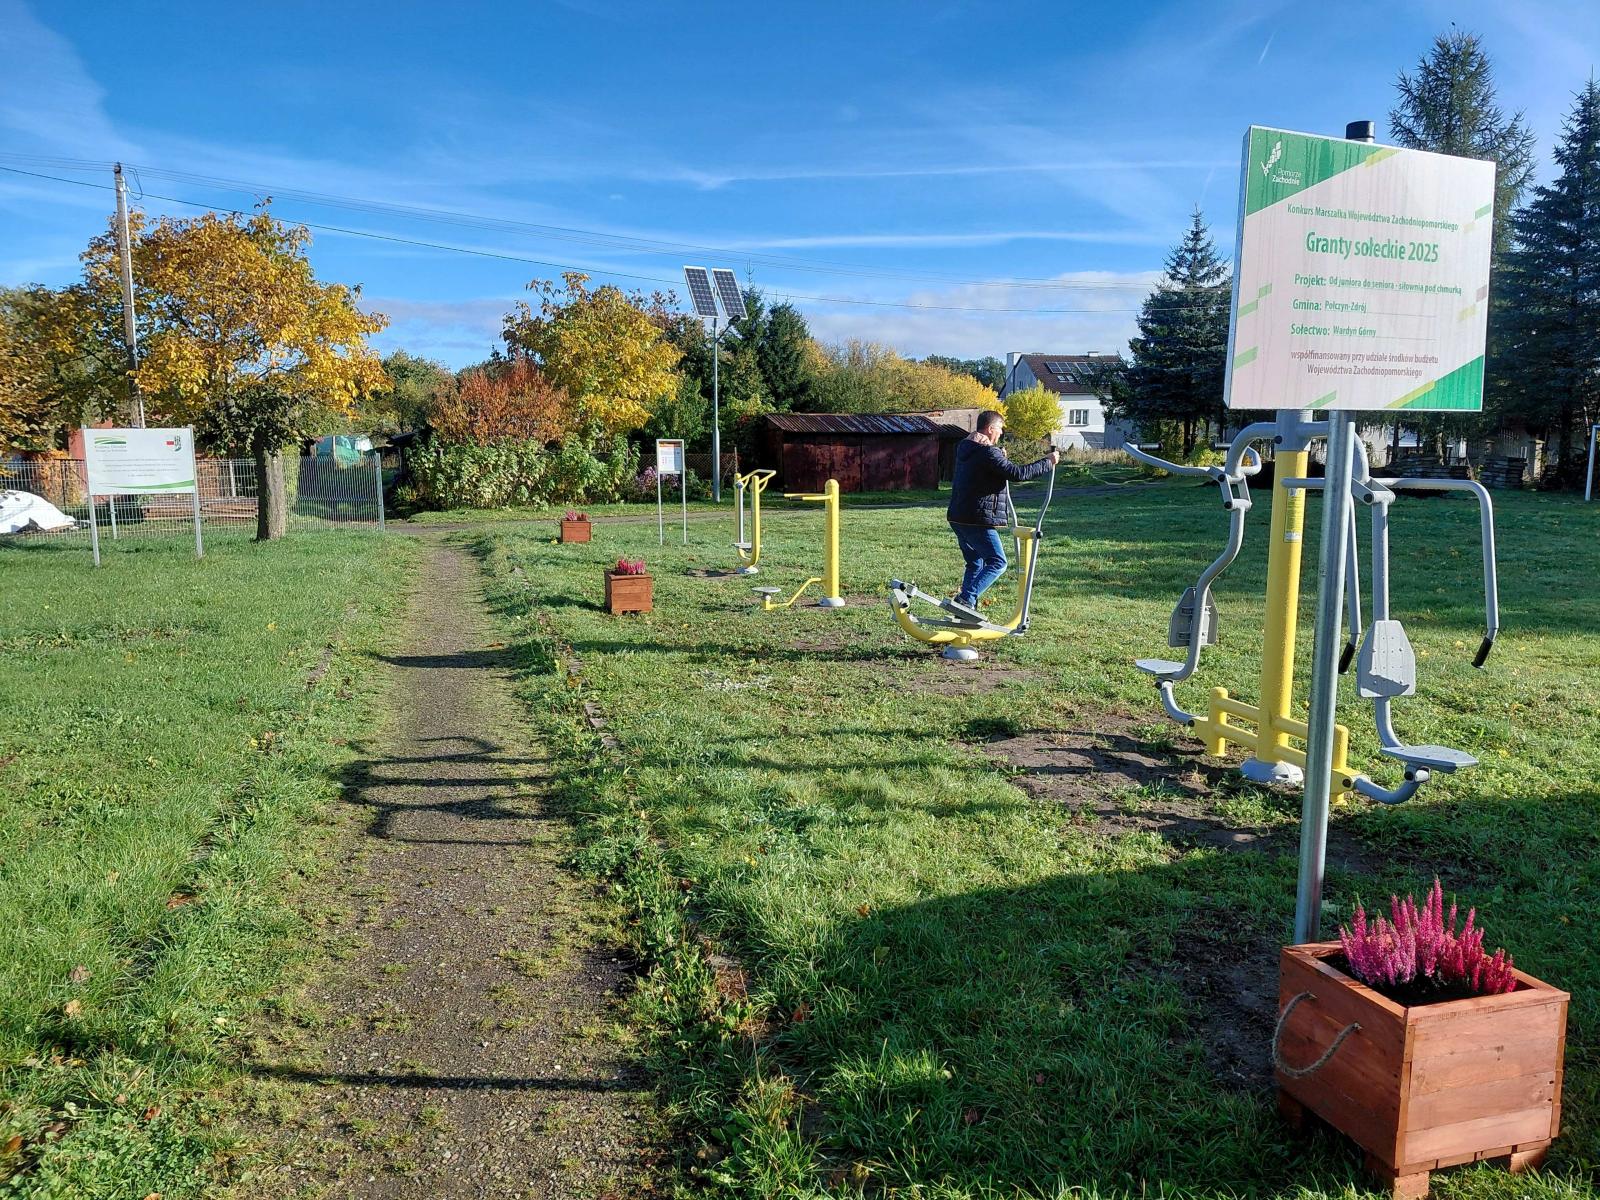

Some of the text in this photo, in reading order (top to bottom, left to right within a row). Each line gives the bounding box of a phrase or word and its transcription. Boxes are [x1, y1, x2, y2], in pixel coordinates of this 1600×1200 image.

[1272, 174, 1300, 186] Zachodnie
[1287, 203, 1459, 232] Konkurs Marszałka Województwa Zachodniopomorskiego
[1306, 231, 1439, 263] Granty sołeckie 2025
[1294, 273, 1326, 288] Projekt:
[1329, 276, 1338, 285] Od
[1338, 277, 1361, 288] juniora
[1363, 278, 1371, 287] do
[1372, 280, 1394, 289] seniora
[1398, 281, 1424, 291] siłownia
[1424, 284, 1437, 294] pod
[1437, 284, 1462, 296] chmurką
[1293, 298, 1367, 313] Gmina: Połczyn-Zdrój
[1291, 323, 1377, 338] Sołectwo: Wardyn Górny
[1291, 349, 1439, 364] współfinansowany przy udziale środków budżetu
[1307, 363, 1423, 379] Województwa Zachodniopomorskiego
